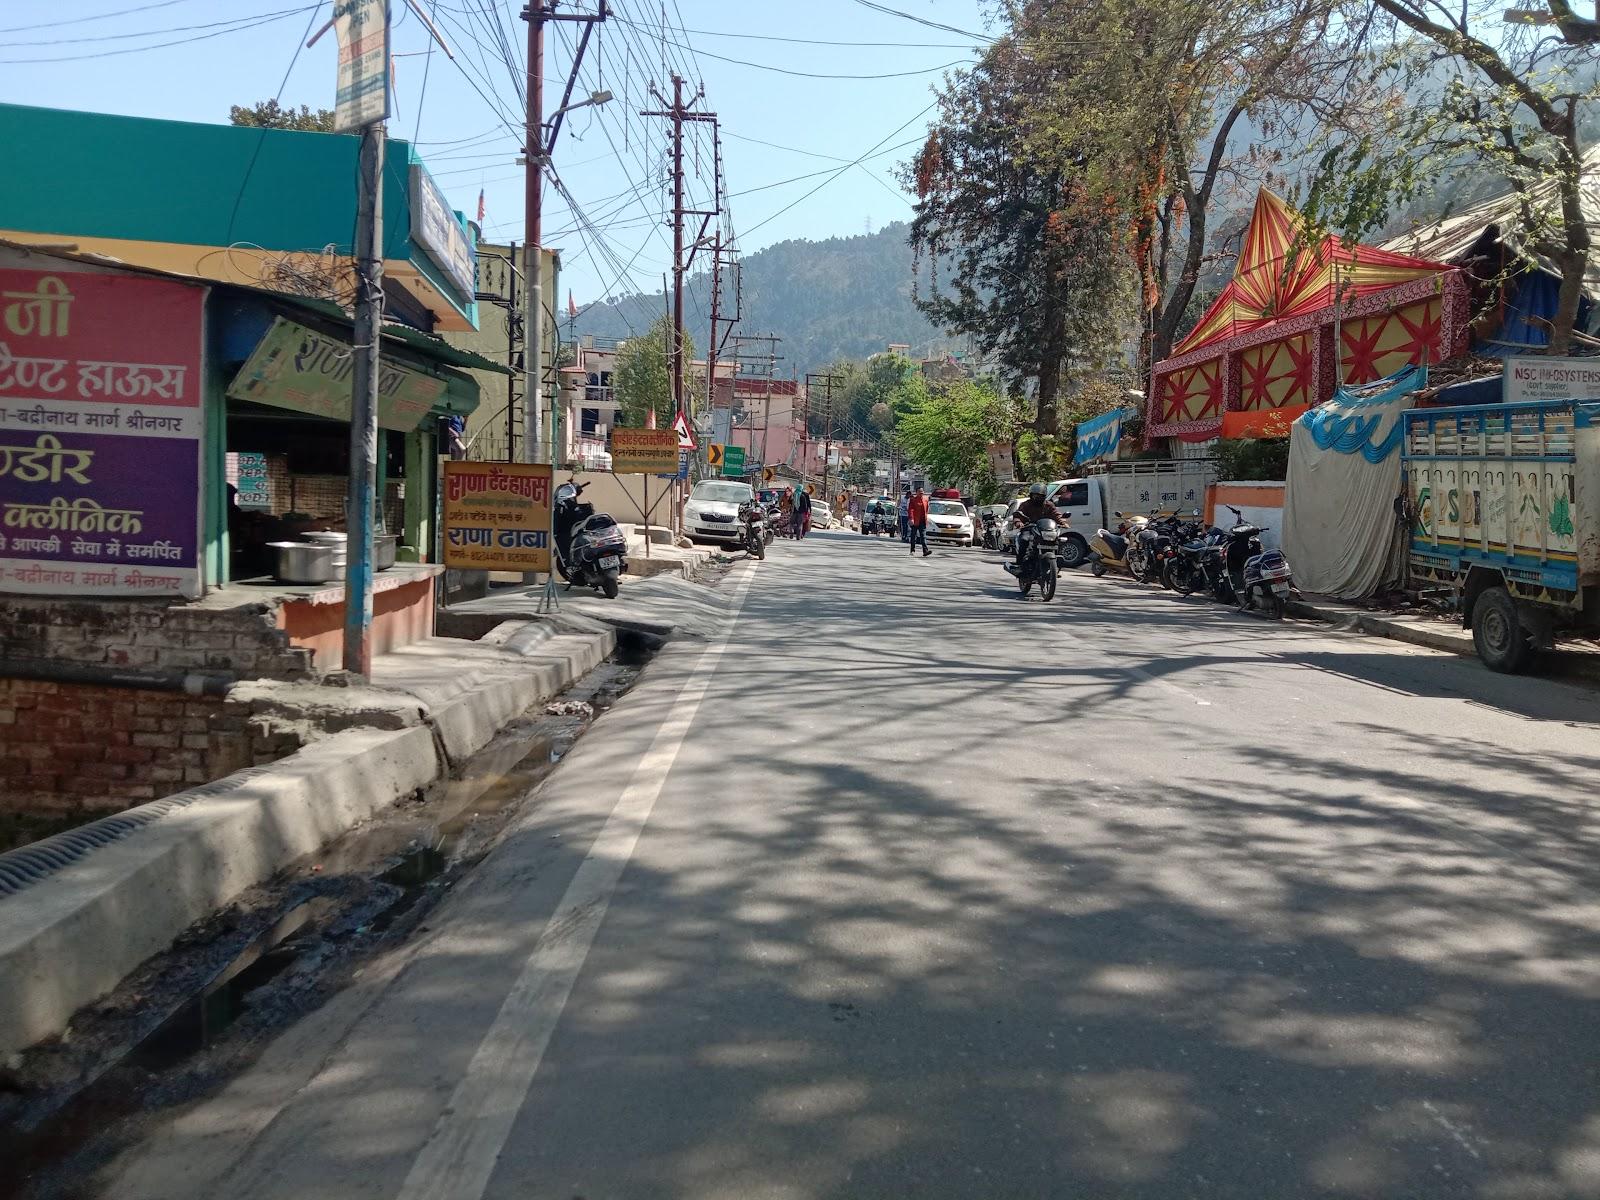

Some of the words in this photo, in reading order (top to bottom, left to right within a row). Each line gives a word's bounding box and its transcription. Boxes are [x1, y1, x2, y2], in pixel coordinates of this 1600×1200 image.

[2, 276, 75, 337] जी
[76, 360, 188, 399] हाऊस
[1515, 367, 1537, 381] NSC
[84, 408, 120, 428] मार्ग
[126, 409, 183, 432] श्रीनगर
[1139, 489, 1150, 502] श्री
[1161, 492, 1177, 501] बाला
[1184, 488, 1194, 501] जी
[3, 496, 144, 535] क्लीनिक
[12, 534, 63, 554] आपकी
[71, 536, 102, 556] सेवा
[106, 538, 121, 557] में
[126, 540, 183, 560] समर्पित
[447, 527, 493, 547] राणा
[497, 528, 548, 549] ढाबा
[82, 567, 118, 589] मार्ग
[123, 569, 184, 591] श्रीनगर
